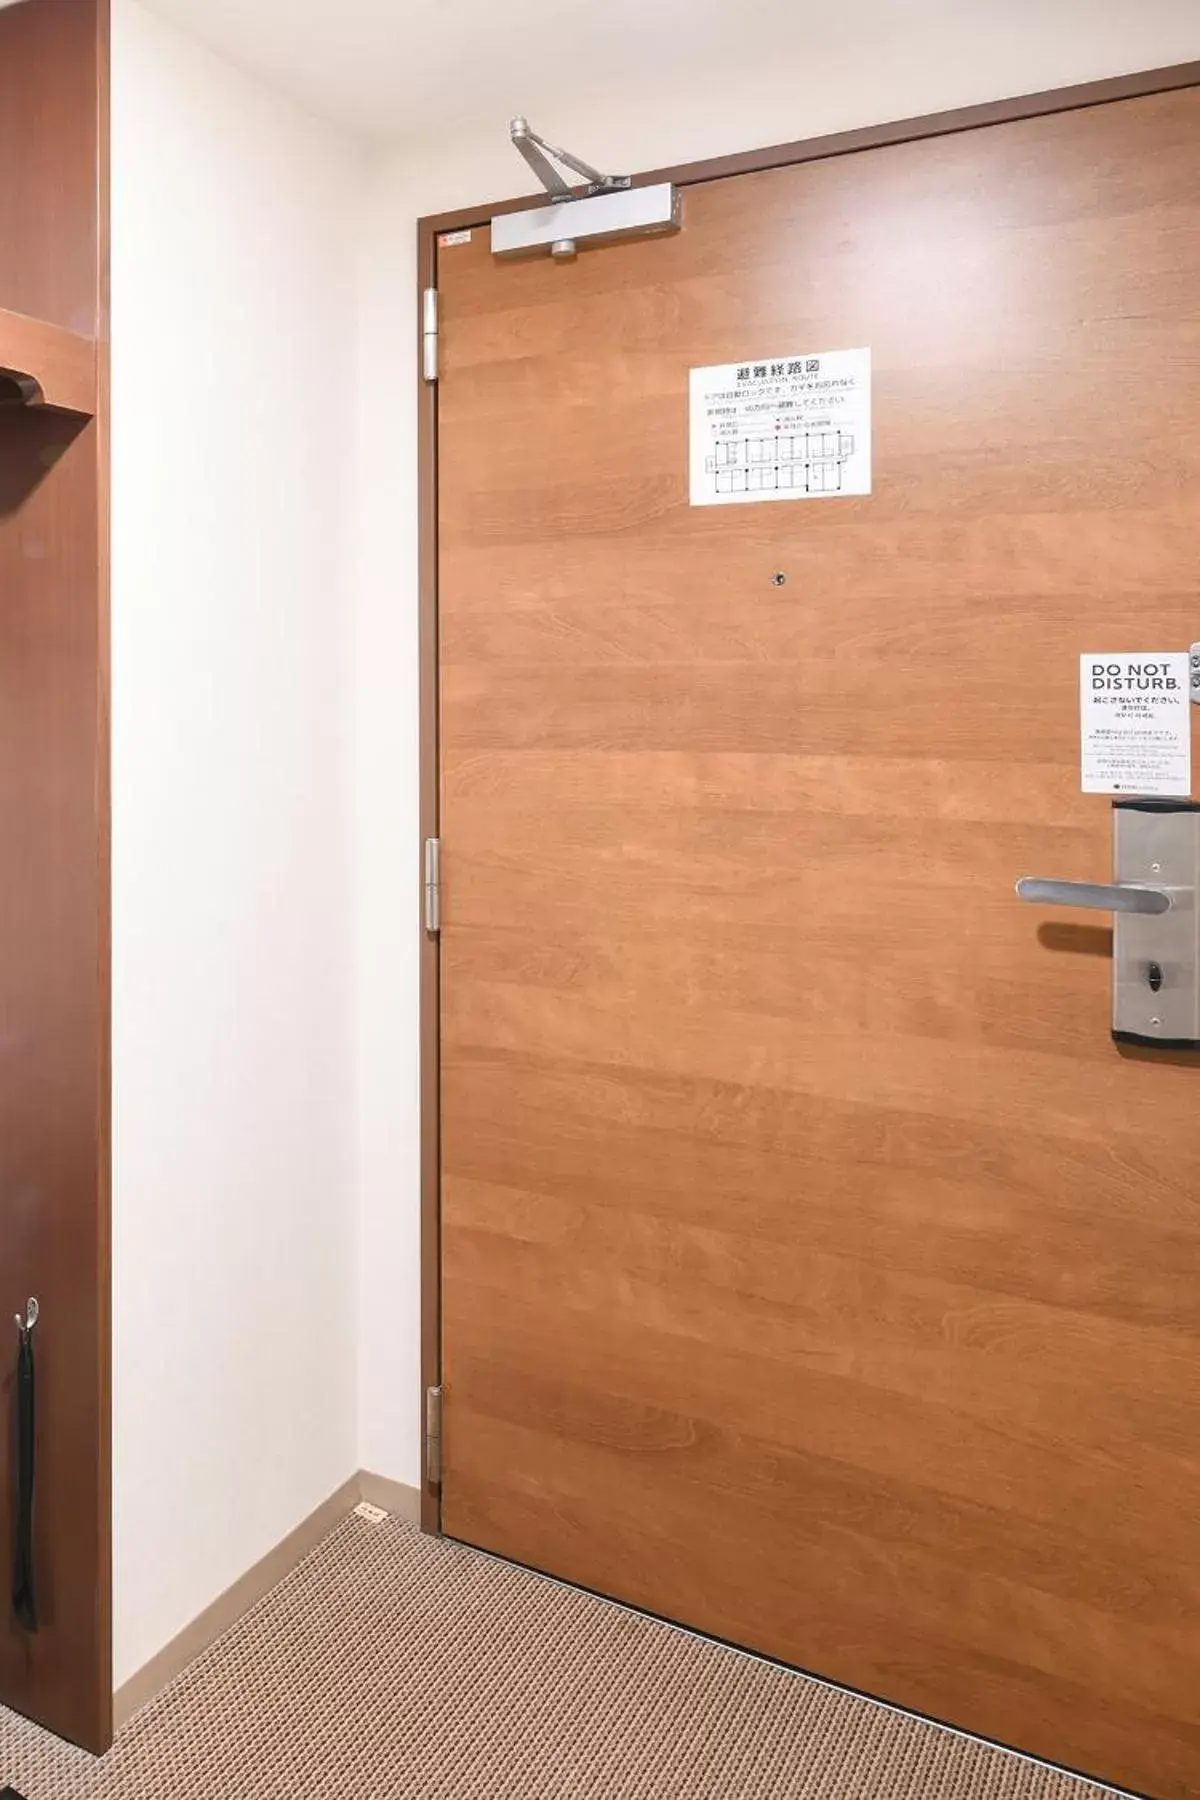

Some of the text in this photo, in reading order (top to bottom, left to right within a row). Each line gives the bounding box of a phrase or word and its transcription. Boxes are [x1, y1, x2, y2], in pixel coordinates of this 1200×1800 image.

[736, 359, 820, 380] 避難経路図
[1092, 664, 1171, 676] DO NOT
[1092, 677, 1181, 690] DISTURB.
